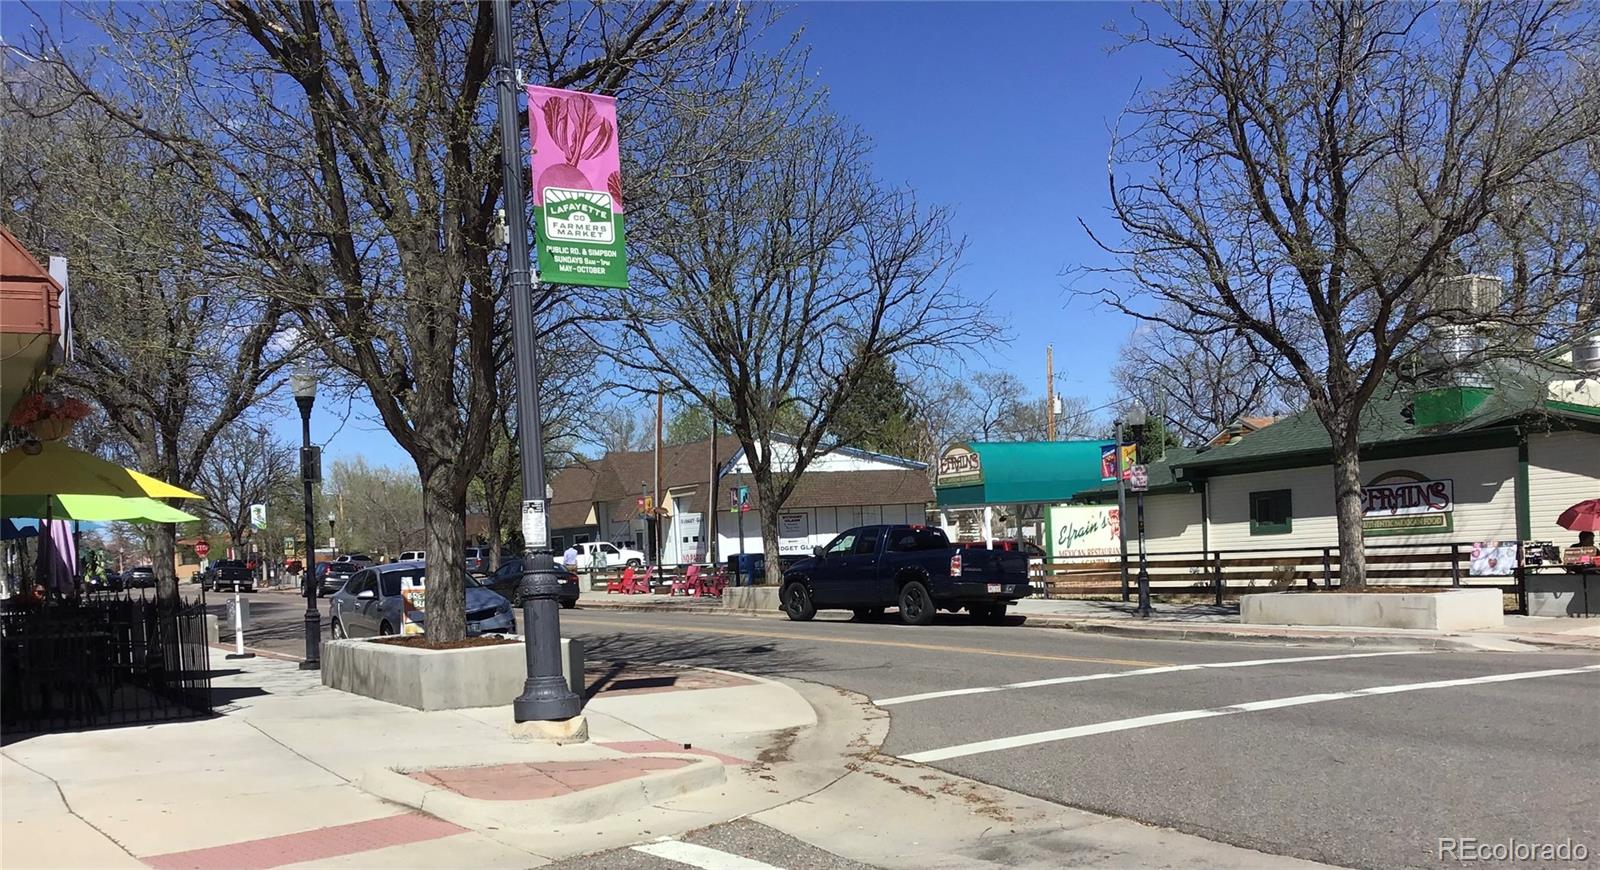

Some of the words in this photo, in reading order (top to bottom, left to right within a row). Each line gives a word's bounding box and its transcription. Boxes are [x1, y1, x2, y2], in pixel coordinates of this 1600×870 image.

[550, 203, 607, 219] LAFAYETTE
[552, 222, 607, 232] FARMERS
[557, 229, 604, 238] MARKET
[546, 245, 569, 254] PUBLIC
[581, 248, 588, 256] &
[588, 248, 617, 257] SIMPSON
[553, 255, 584, 265] SUNDAYS
[1362, 519, 1393, 529] UTHENTIC
[1058, 511, 1108, 549] Efrain's
[1087, 547, 1121, 555] RESTAURAN
